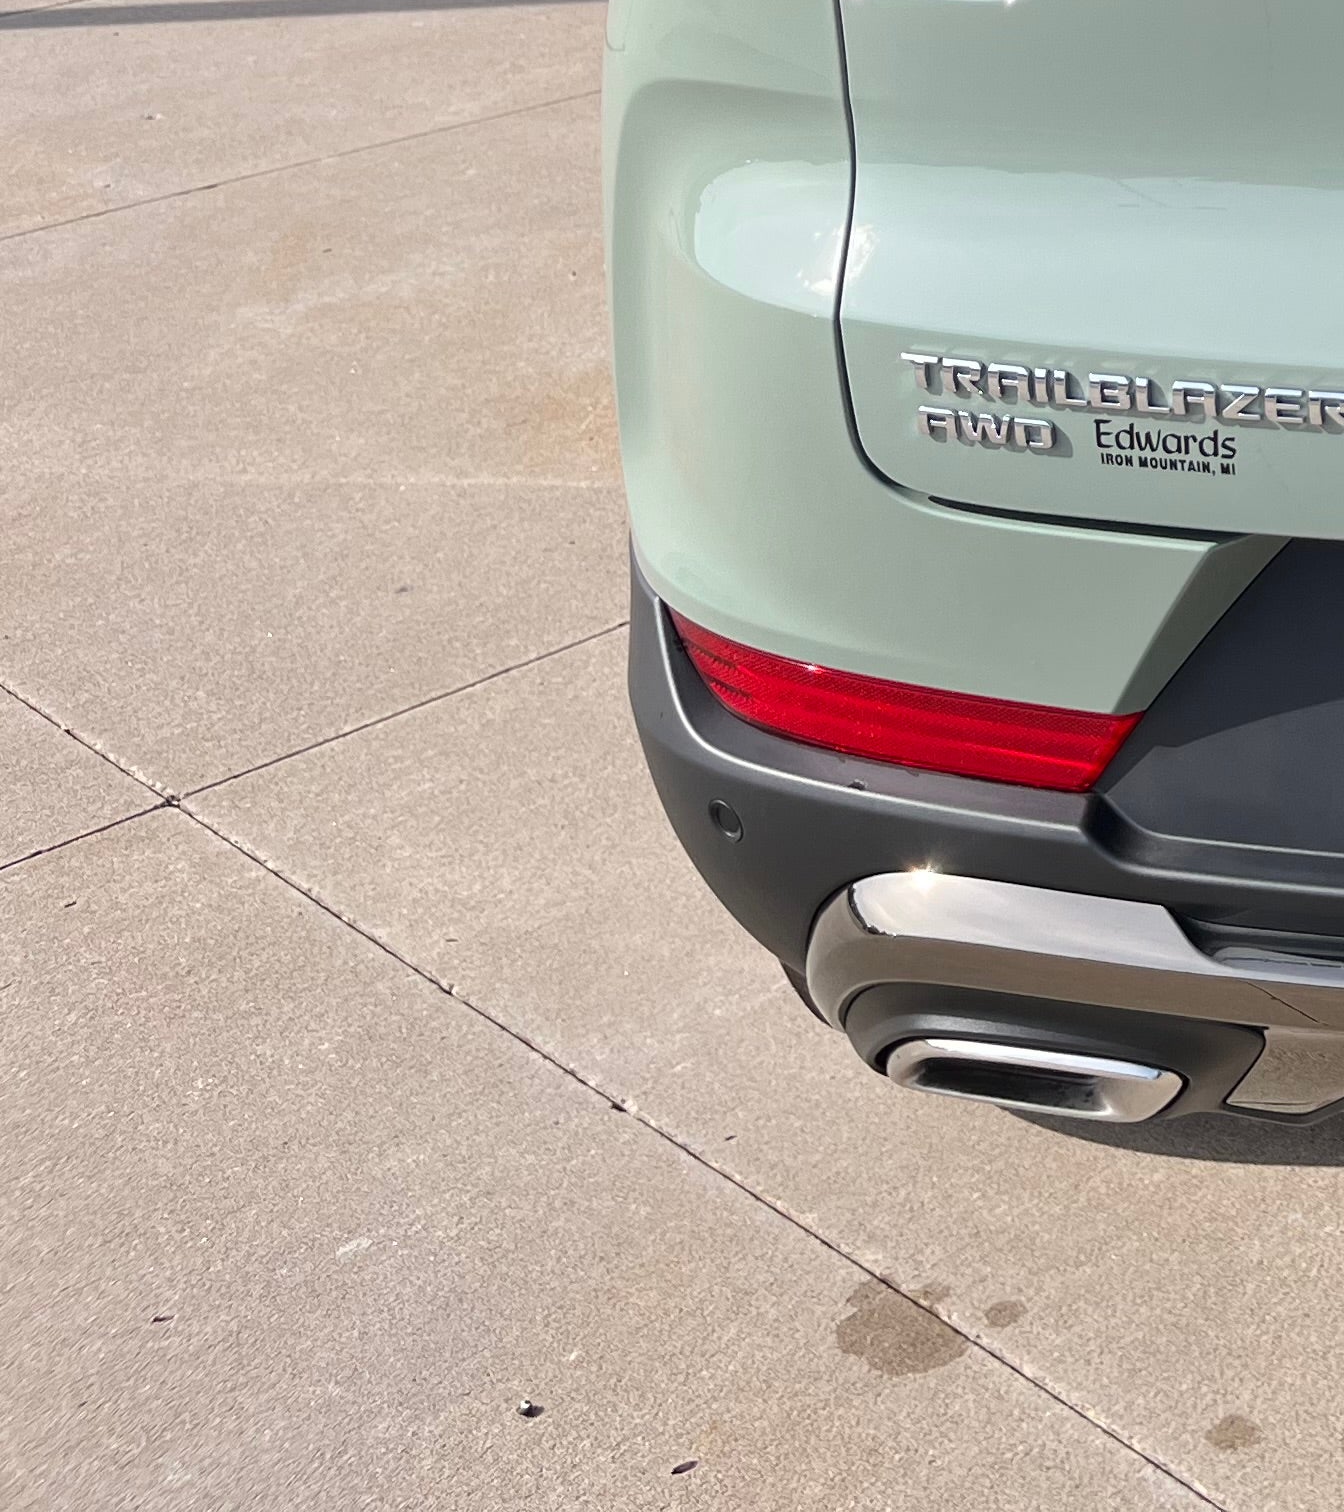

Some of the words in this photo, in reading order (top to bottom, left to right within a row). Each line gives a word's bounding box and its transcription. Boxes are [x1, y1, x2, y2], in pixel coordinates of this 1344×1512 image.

[917, 405, 1056, 451] AWD
[1094, 419, 1237, 459] Edwards
[1101, 452, 1134, 467] IRON
[1138, 456, 1216, 476] MOUNTAIN,
[1220, 463, 1236, 476] MI
